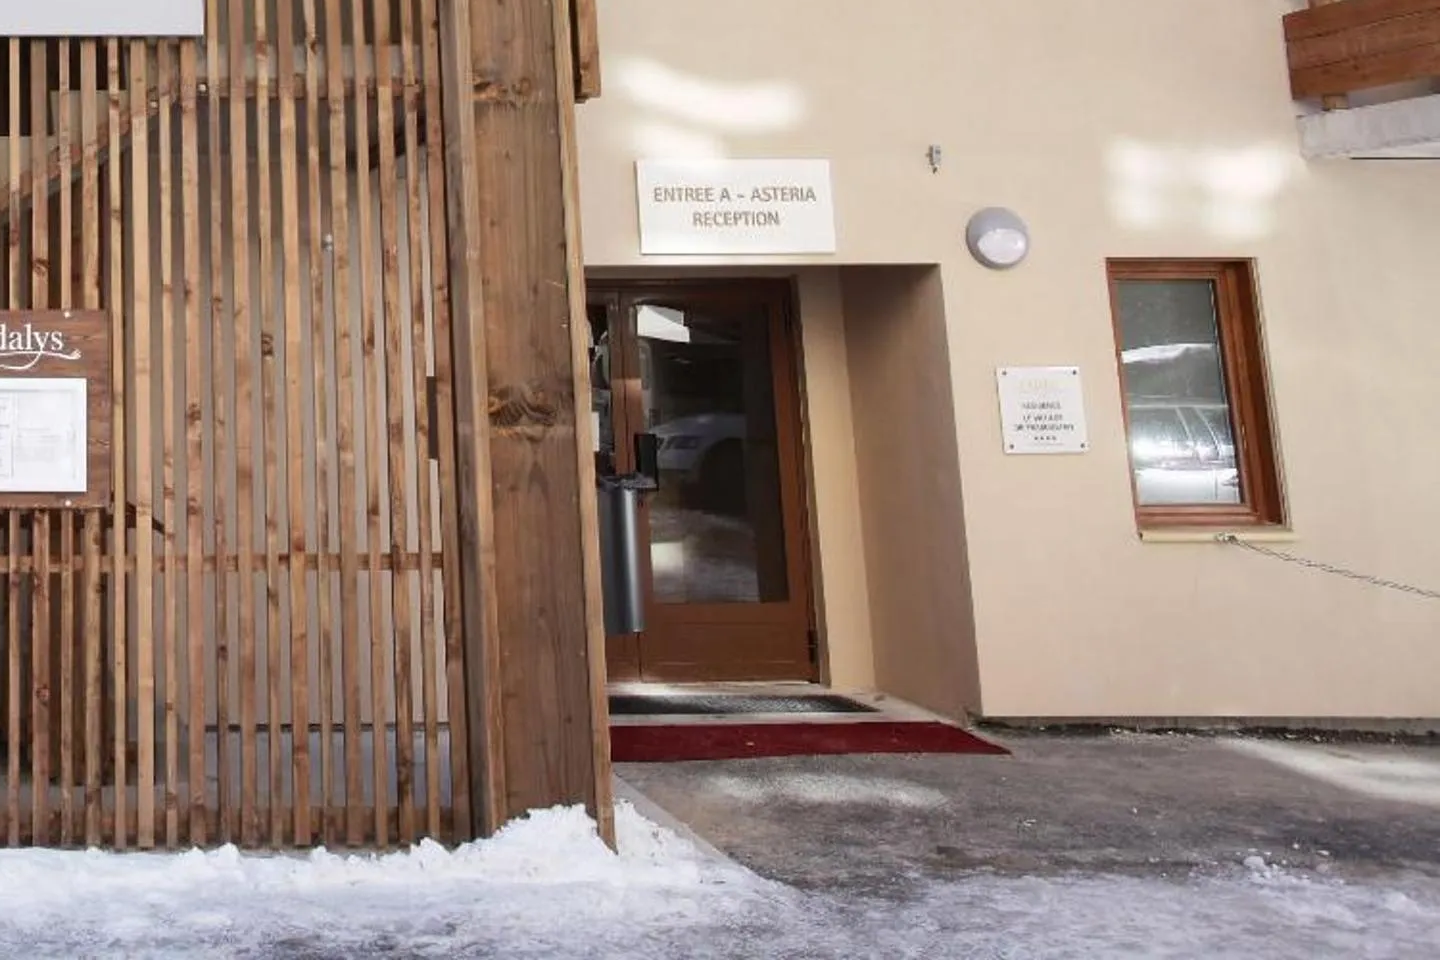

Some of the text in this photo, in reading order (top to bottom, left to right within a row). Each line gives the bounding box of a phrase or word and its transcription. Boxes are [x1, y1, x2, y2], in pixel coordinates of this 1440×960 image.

[653, 187, 715, 203] ENTREE
[719, 187, 731, 202] A
[750, 186, 817, 203] ASTERIA
[692, 210, 780, 227] RECEPTION
